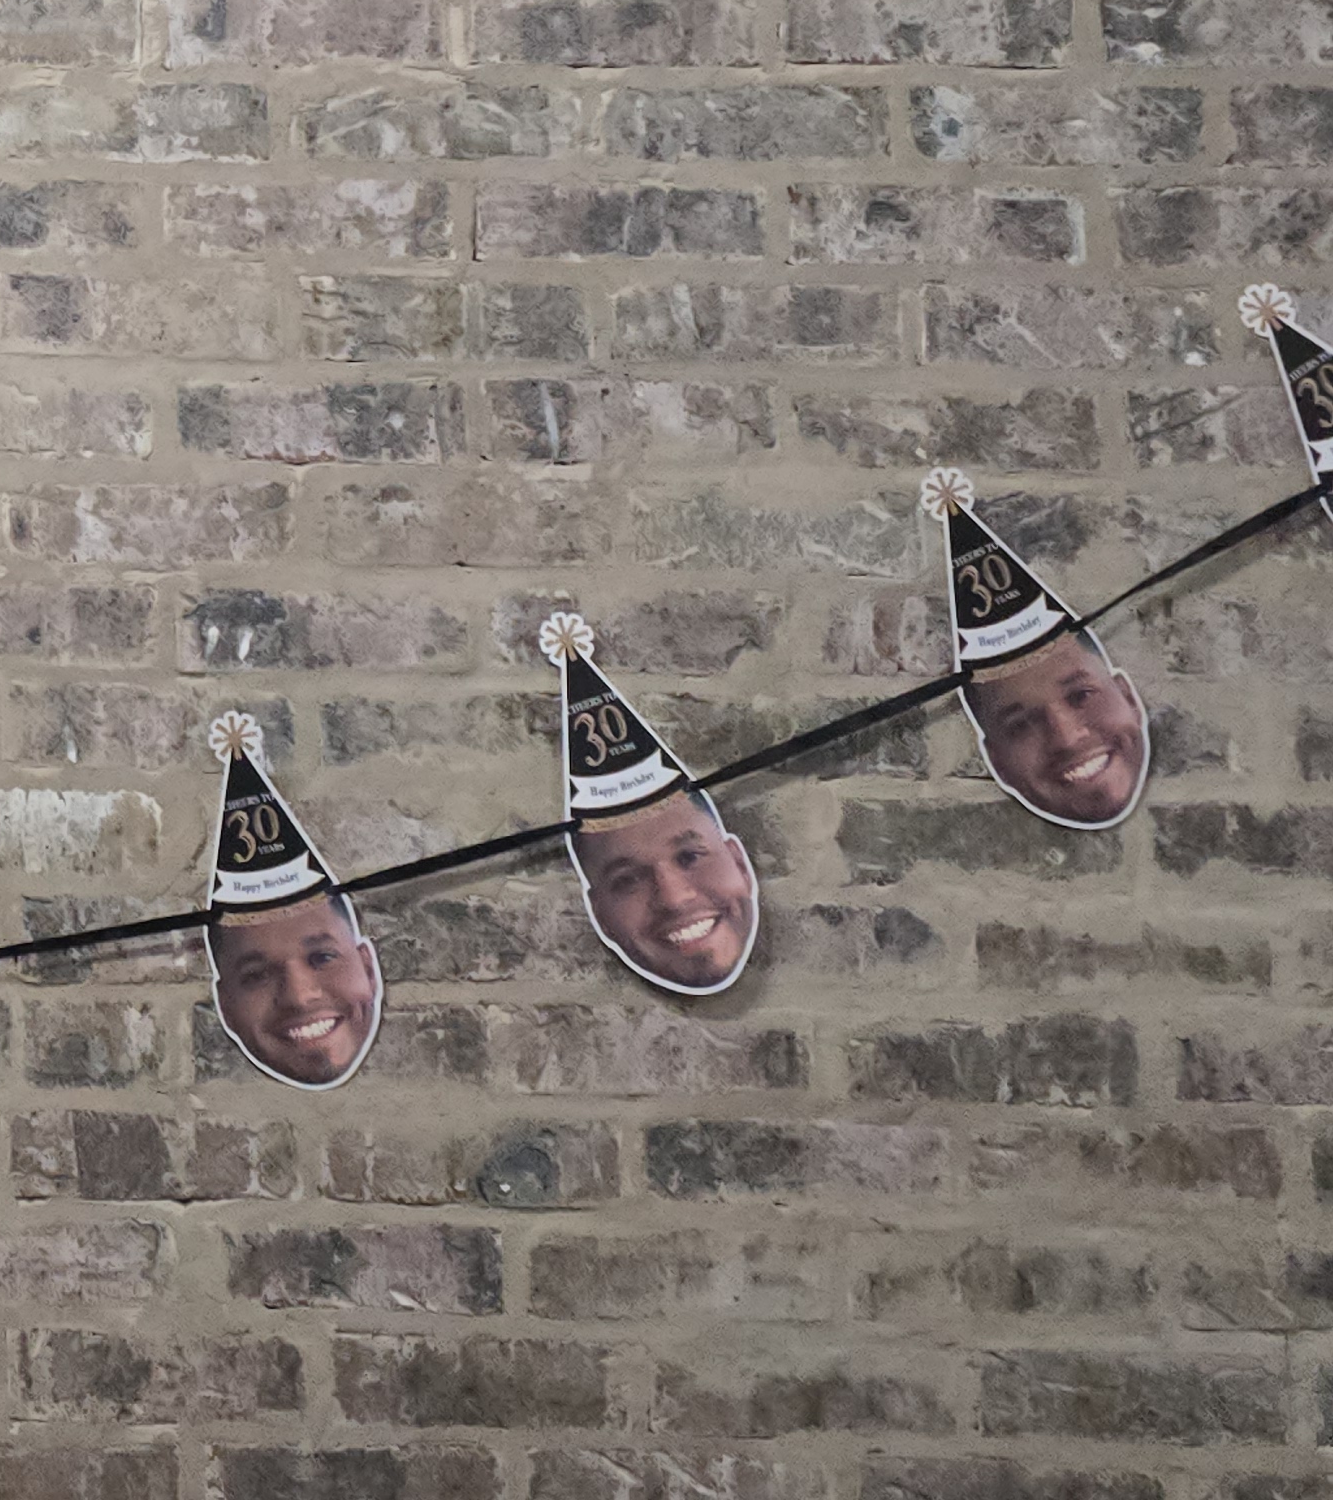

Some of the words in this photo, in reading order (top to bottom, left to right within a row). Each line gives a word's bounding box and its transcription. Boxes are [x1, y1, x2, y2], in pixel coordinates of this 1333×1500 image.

[1289, 358, 1321, 382] HEERS
[957, 554, 1012, 618] 30
[977, 634, 1006, 647] Happy
[1006, 616, 1042, 639] Birthday
[574, 704, 628, 767] 30
[589, 786, 619, 799] Happy
[619, 771, 656, 791] Birthday
[226, 804, 280, 864] 30
[233, 881, 261, 895] Happy
[263, 872, 300, 889] Birthday
